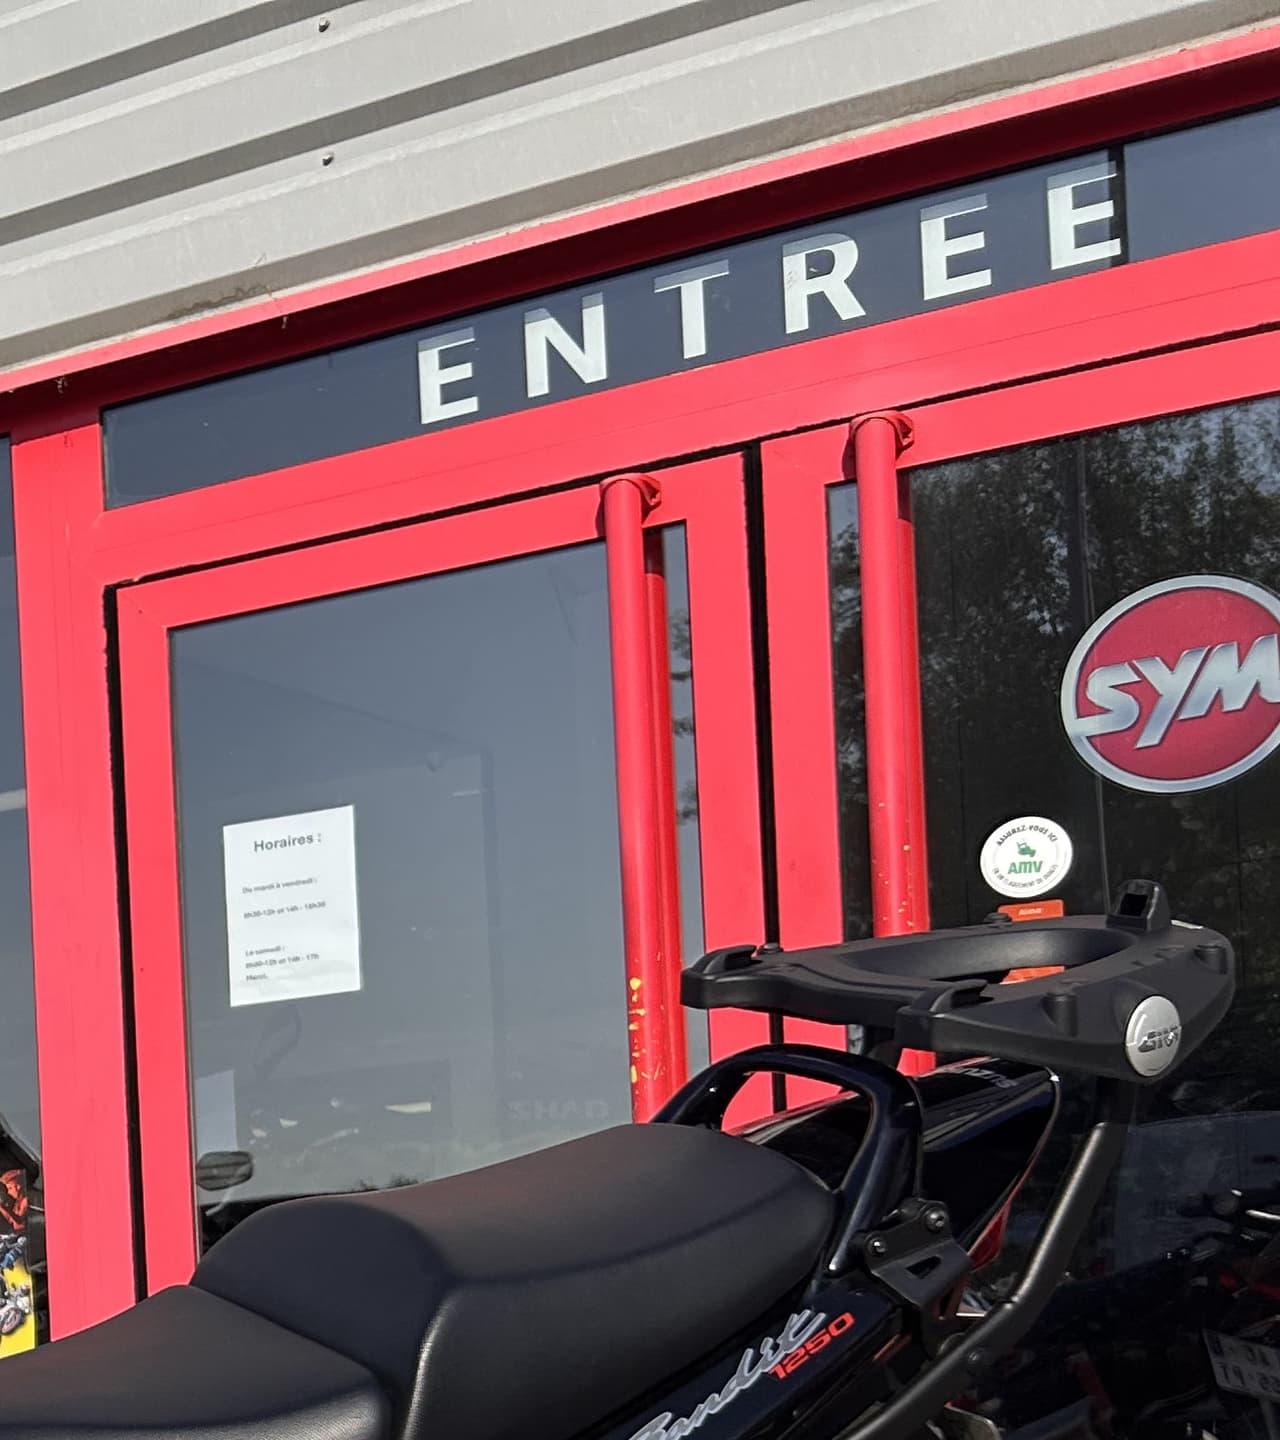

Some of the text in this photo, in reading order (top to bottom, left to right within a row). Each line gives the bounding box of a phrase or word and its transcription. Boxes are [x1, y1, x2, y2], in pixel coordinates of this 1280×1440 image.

[417, 161, 1121, 425] ENTREE
[1075, 633, 1280, 749] SYM
[253, 834, 315, 853] Horaires
[767, 1311, 856, 1380] 1250
